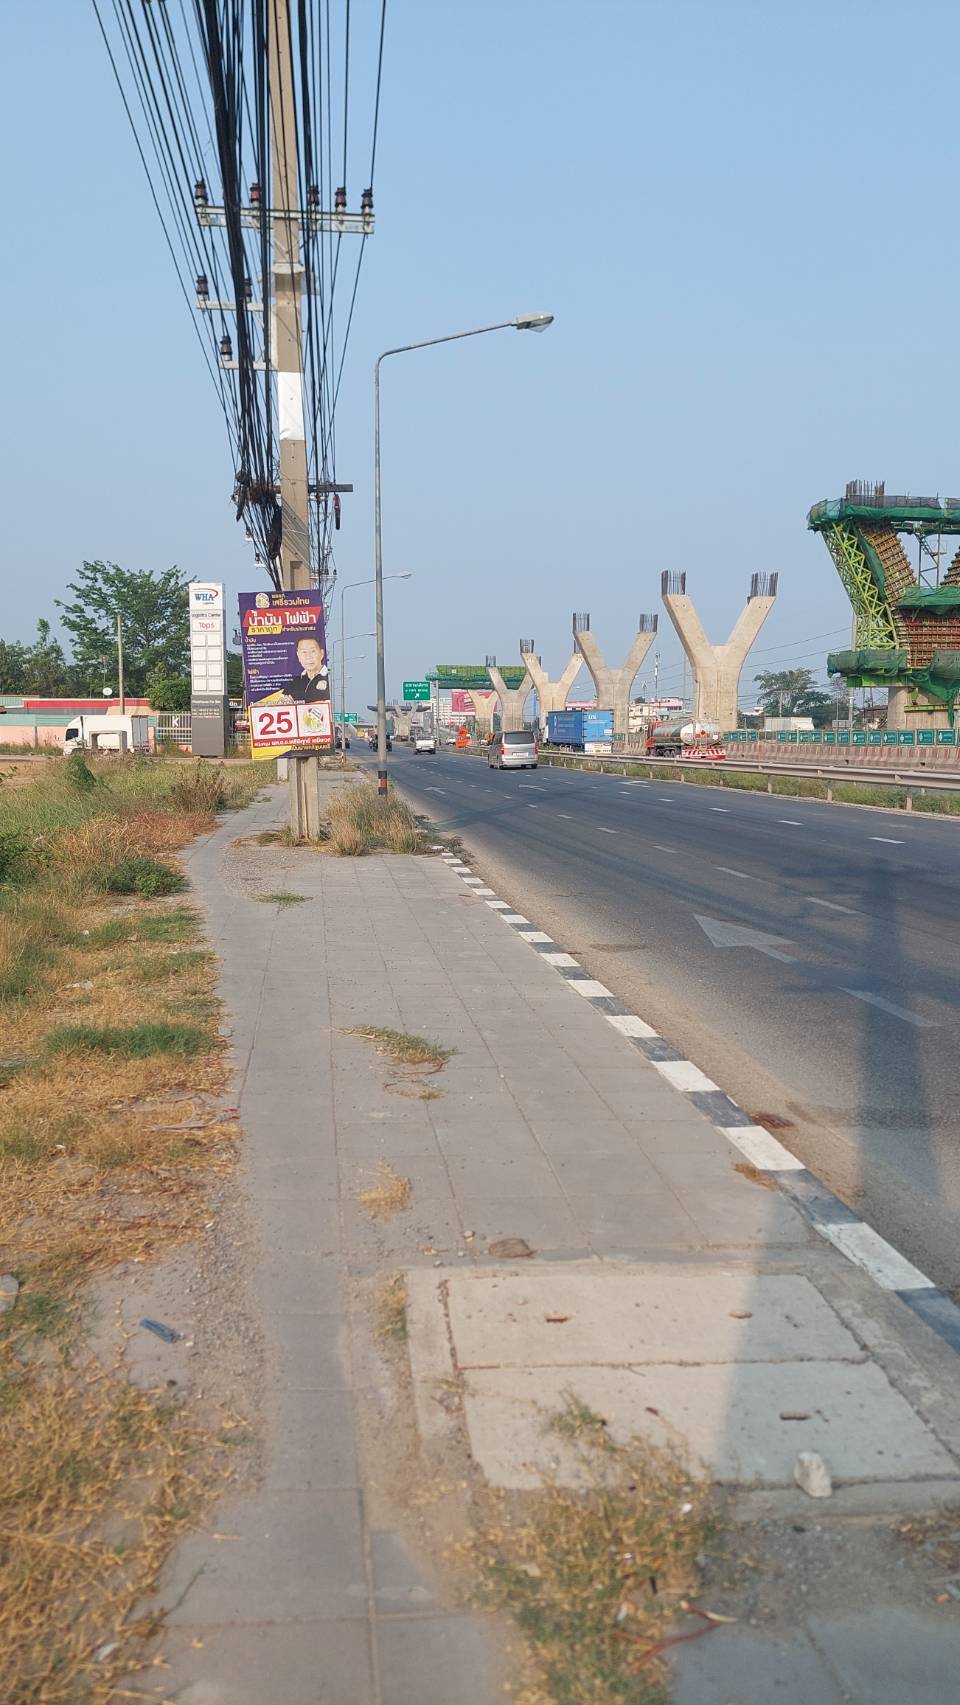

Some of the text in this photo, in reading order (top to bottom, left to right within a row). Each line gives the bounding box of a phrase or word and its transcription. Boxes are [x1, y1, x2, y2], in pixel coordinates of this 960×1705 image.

[194, 593, 214, 601] WHA
[272, 597, 310, 606] เสรีรวมไทย
[248, 610, 316, 626] น้ำมัน ไฟฟ้า
[251, 626, 278, 634] ราคาถูก
[258, 711, 293, 735] 25
